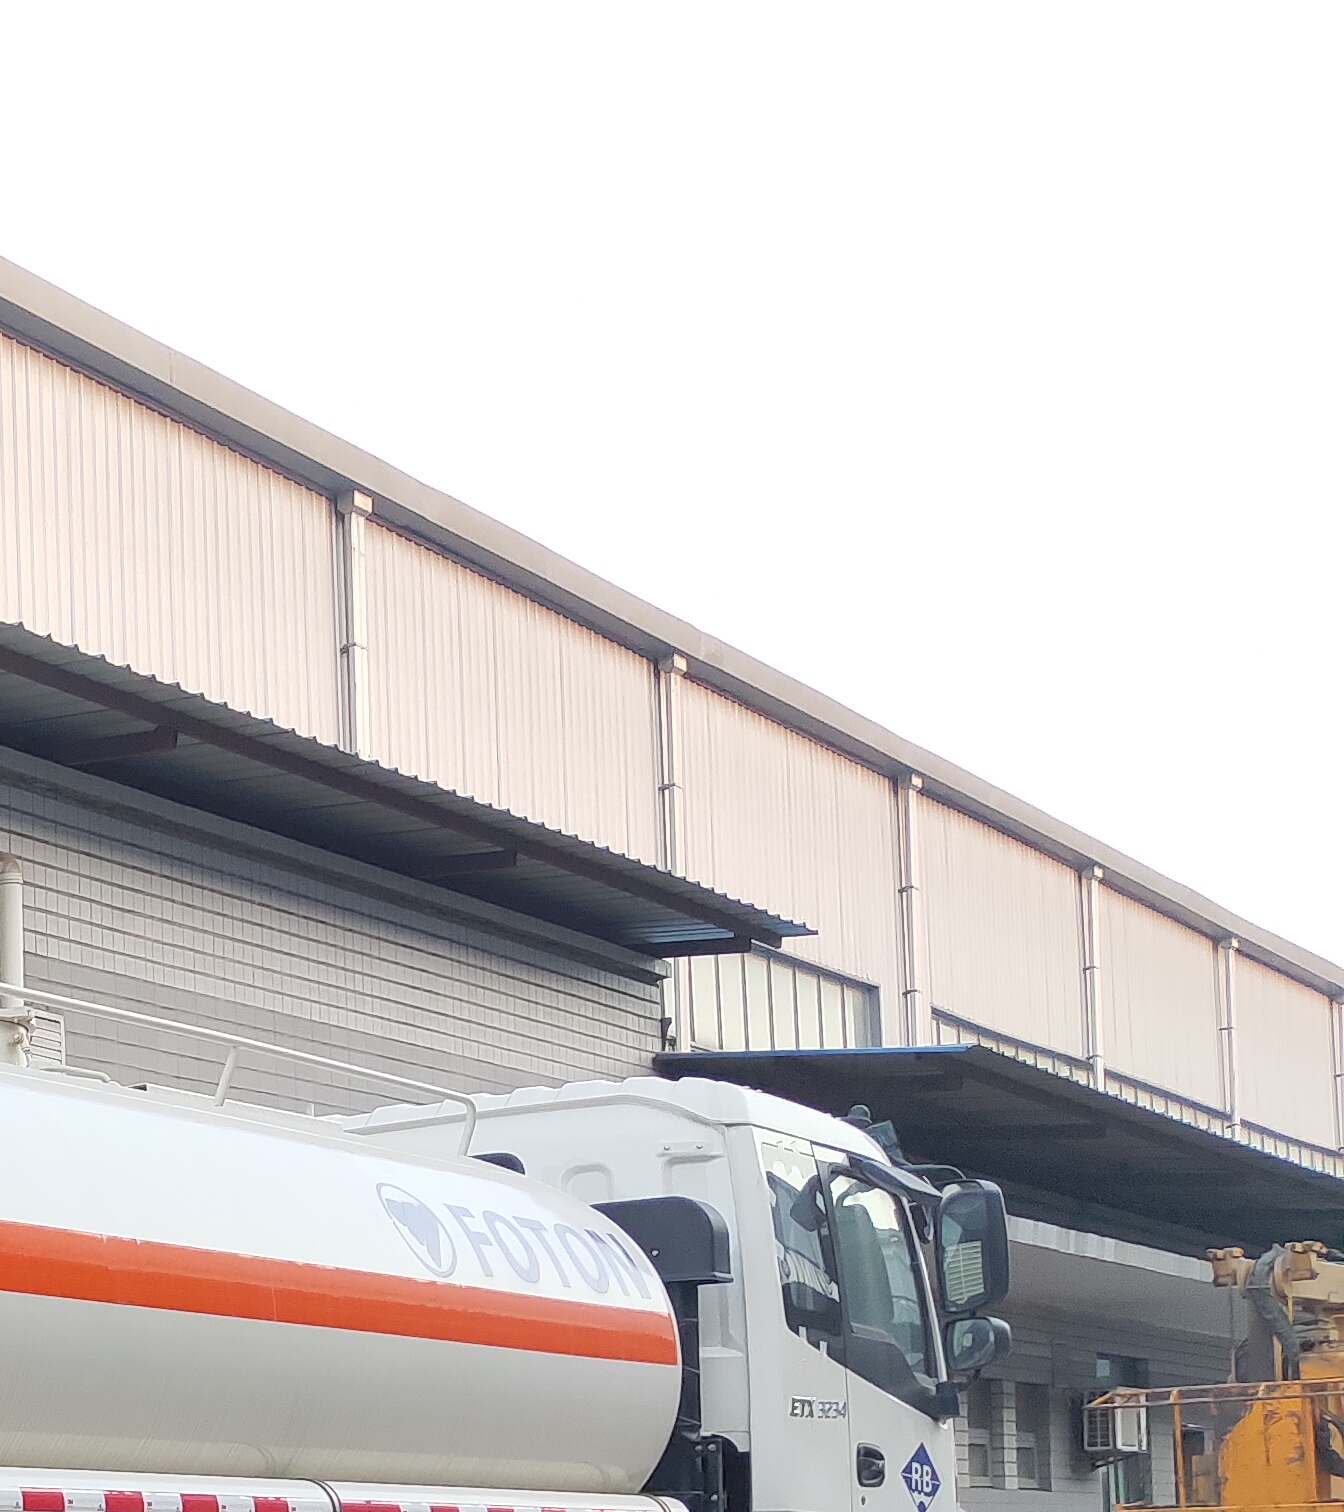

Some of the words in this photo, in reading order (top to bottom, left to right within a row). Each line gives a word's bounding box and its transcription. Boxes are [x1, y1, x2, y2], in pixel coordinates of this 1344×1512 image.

[443, 1203, 652, 1300] FOTON
[790, 1395, 817, 1418] ETX
[911, 1461, 933, 1493] RB
